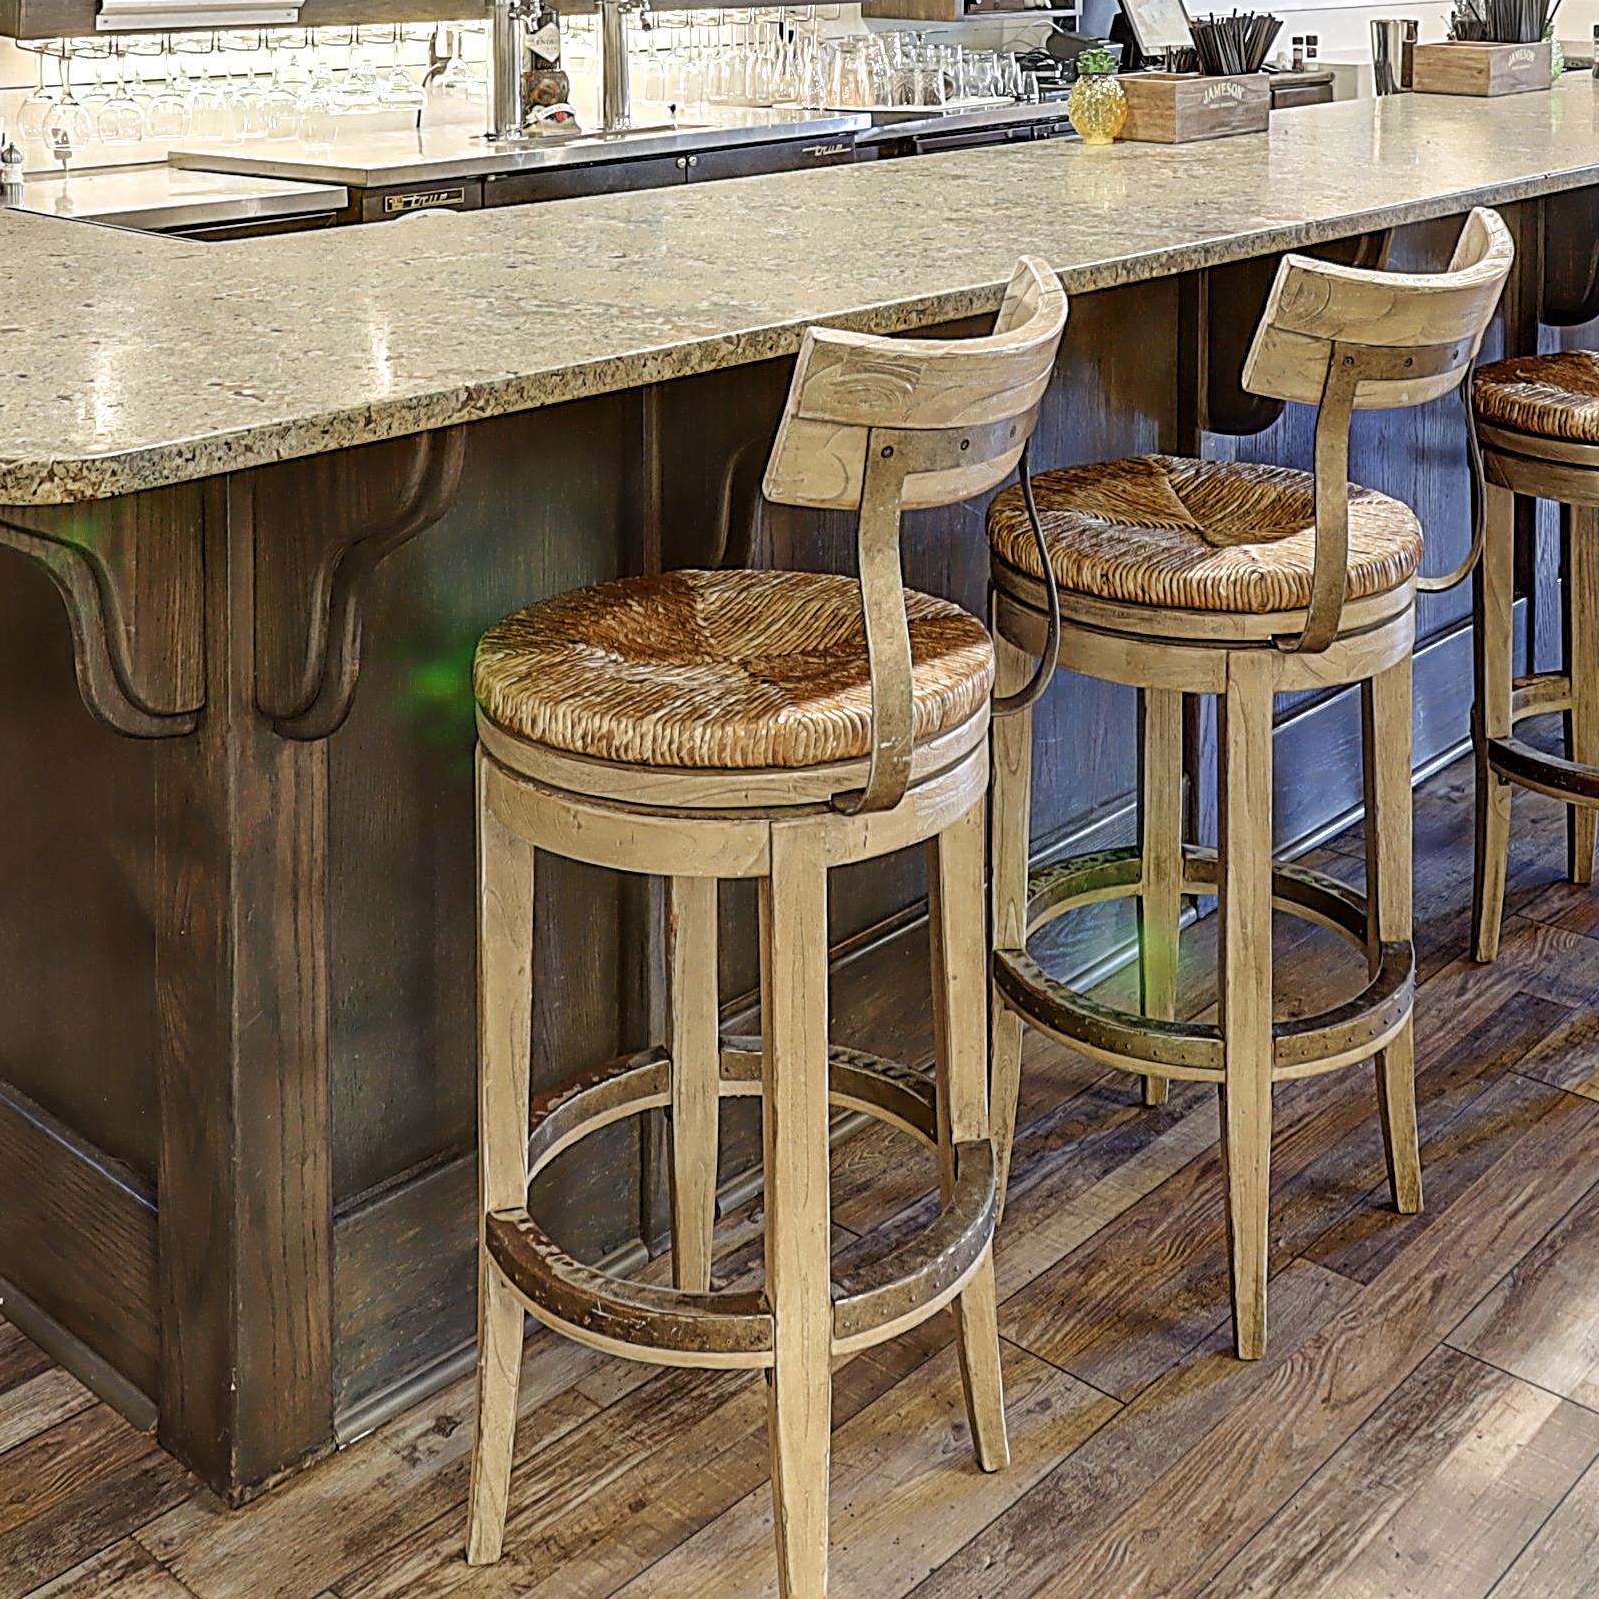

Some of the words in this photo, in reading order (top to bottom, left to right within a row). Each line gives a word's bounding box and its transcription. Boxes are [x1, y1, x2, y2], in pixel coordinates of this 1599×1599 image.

[1507, 49, 1536, 68] JAMESON
[1203, 82, 1243, 105] JAMESON
[814, 143, 844, 157] true
